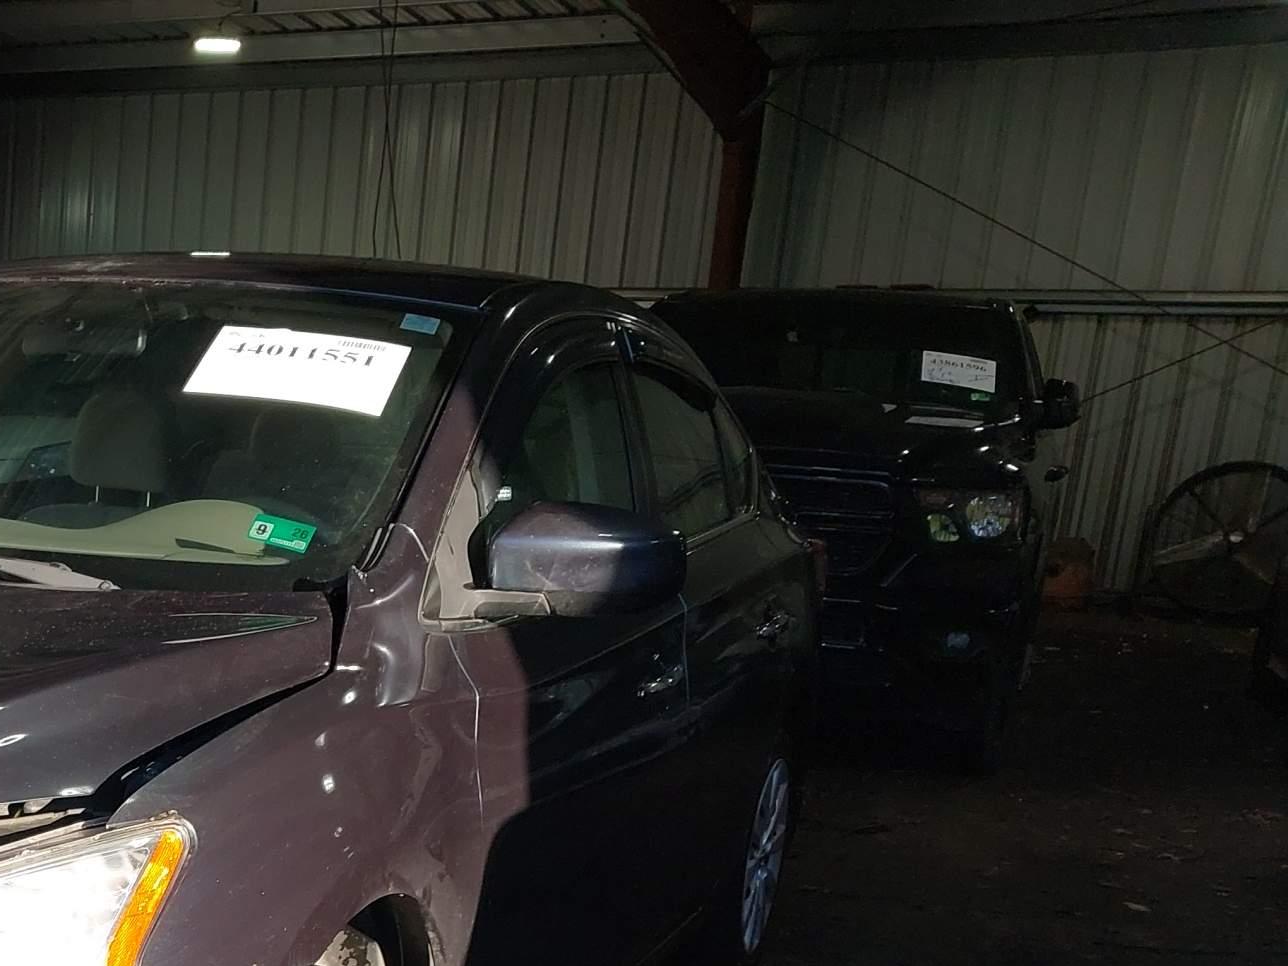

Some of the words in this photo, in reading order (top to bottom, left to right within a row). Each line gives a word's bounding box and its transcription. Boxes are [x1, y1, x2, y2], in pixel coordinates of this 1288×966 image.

[227, 341, 375, 367] 44011551
[255, 523, 268, 536] 9
[291, 527, 310, 540] 26
